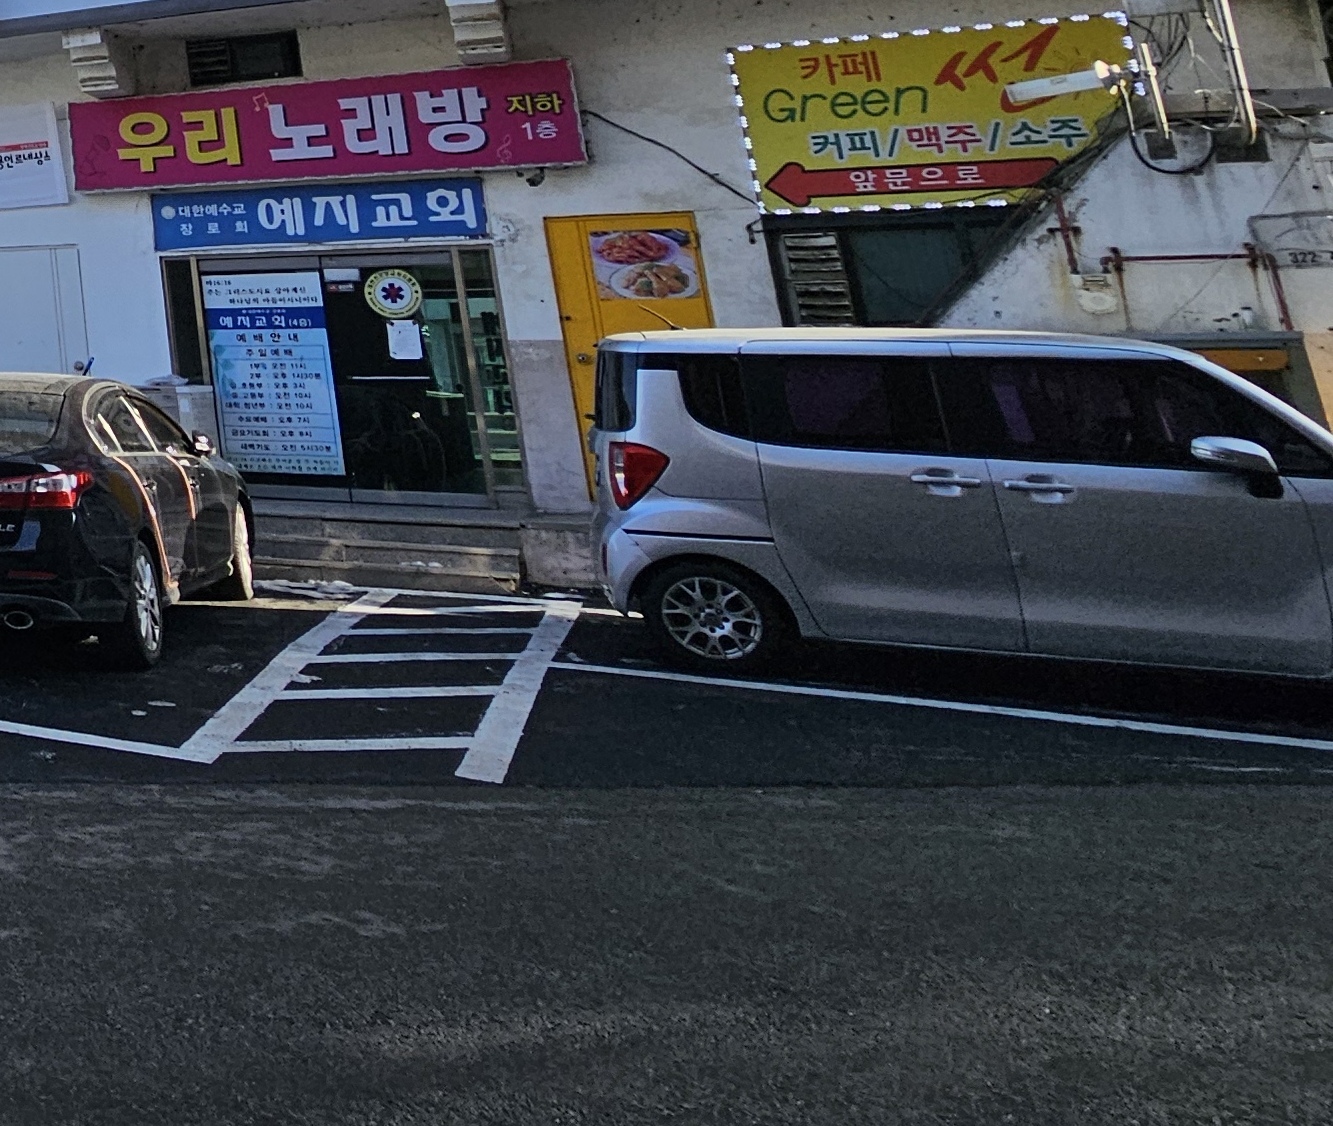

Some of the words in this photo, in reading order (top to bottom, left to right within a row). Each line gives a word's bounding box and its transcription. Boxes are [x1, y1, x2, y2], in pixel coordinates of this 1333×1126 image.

[798, 50, 882, 85] 카페
[763, 85, 929, 123] Green
[116, 107, 242, 172] 우리
[268, 86, 489, 162] 노래방
[507, 93, 564, 116] 지하
[521, 120, 559, 141] 1층
[849, 165, 986, 193] 앞문으로
[178, 203, 247, 218] 대한예수교
[257, 188, 478, 236] 예지교회
[219, 315, 286, 328] 예지교회
